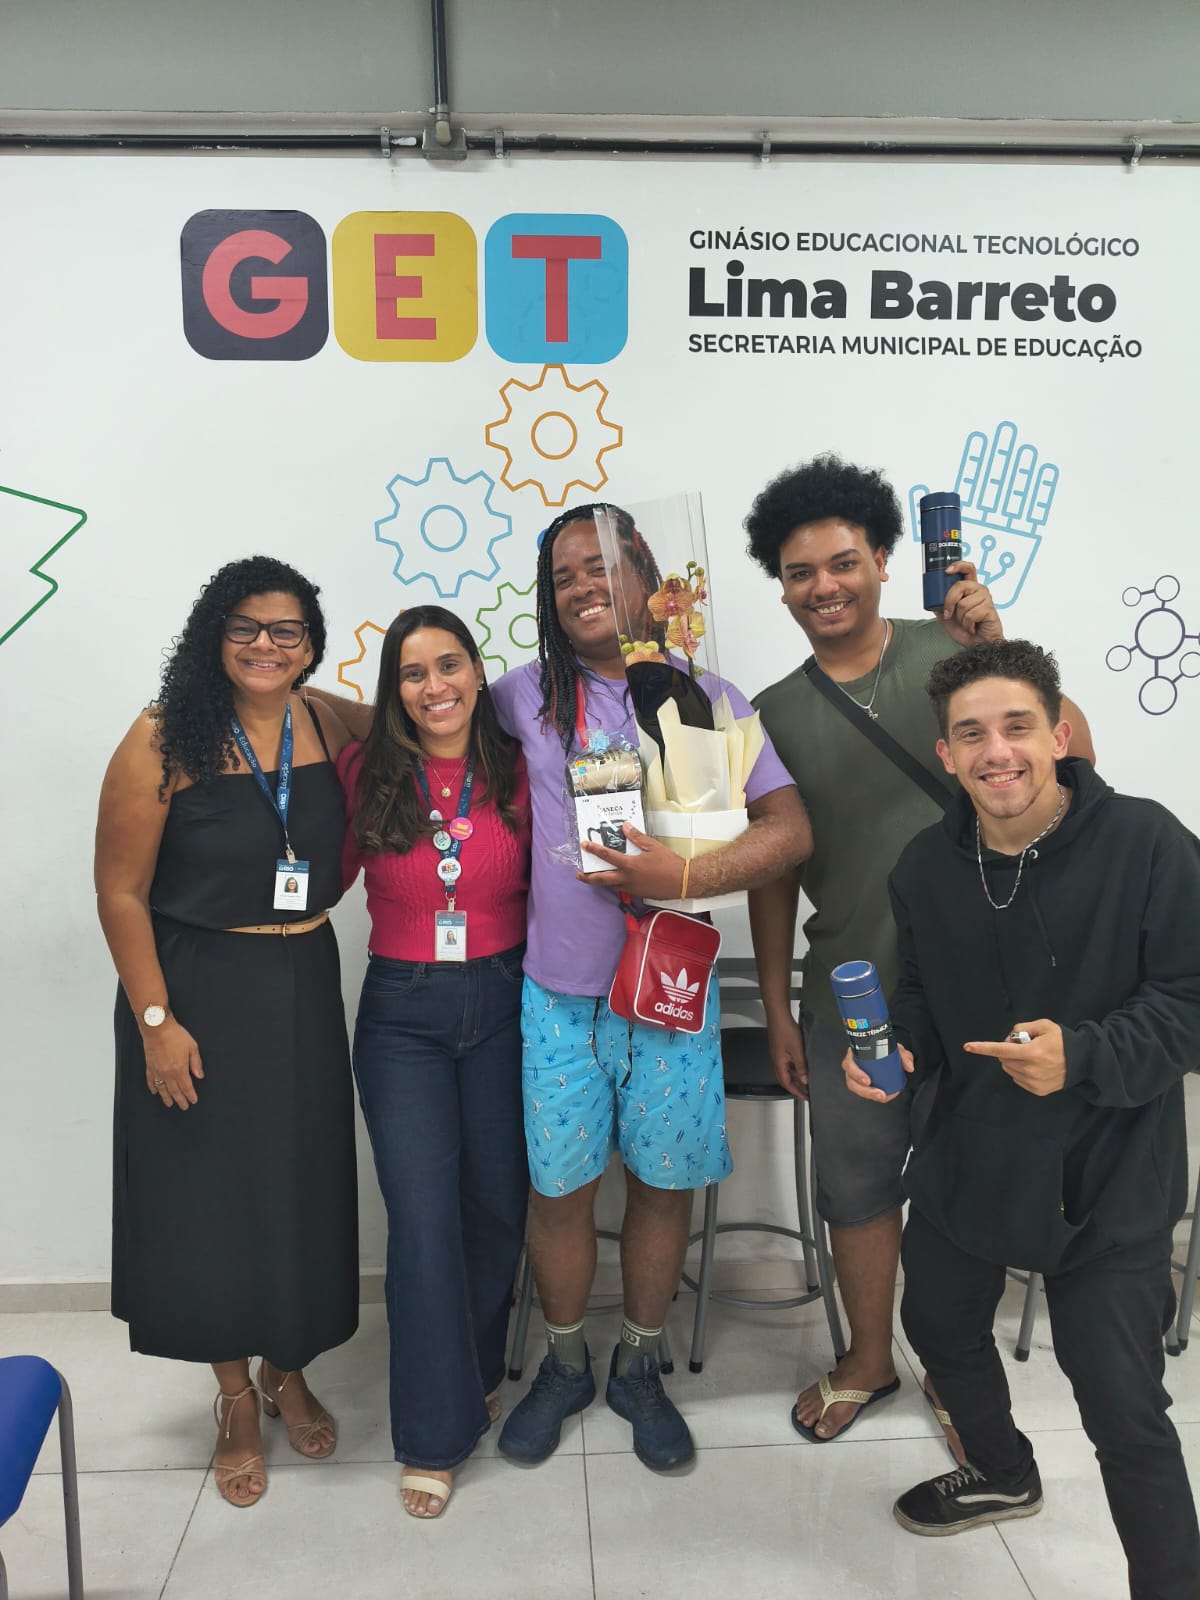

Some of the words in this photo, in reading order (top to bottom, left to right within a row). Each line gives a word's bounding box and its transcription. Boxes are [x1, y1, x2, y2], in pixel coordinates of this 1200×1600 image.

[689, 226, 790, 251] GINÁSIO
[796, 232, 968, 254] EDUCACIONAL
[973, 232, 1140, 257] TECNOLÓGICO
[202, 228, 602, 343] GET
[688, 259, 848, 319] Lima
[870, 269, 1117, 323] Barreto
[688, 333, 836, 355] SECRETARIA
[842, 335, 971, 356] MUNICIPAL
[976, 337, 1008, 357] DE
[1014, 334, 1142, 363] EDUCAÇÃO
[600, 805, 624, 813] ANECA
[654, 1001, 694, 1021] adidas
[843, 1018, 868, 1029] ET
